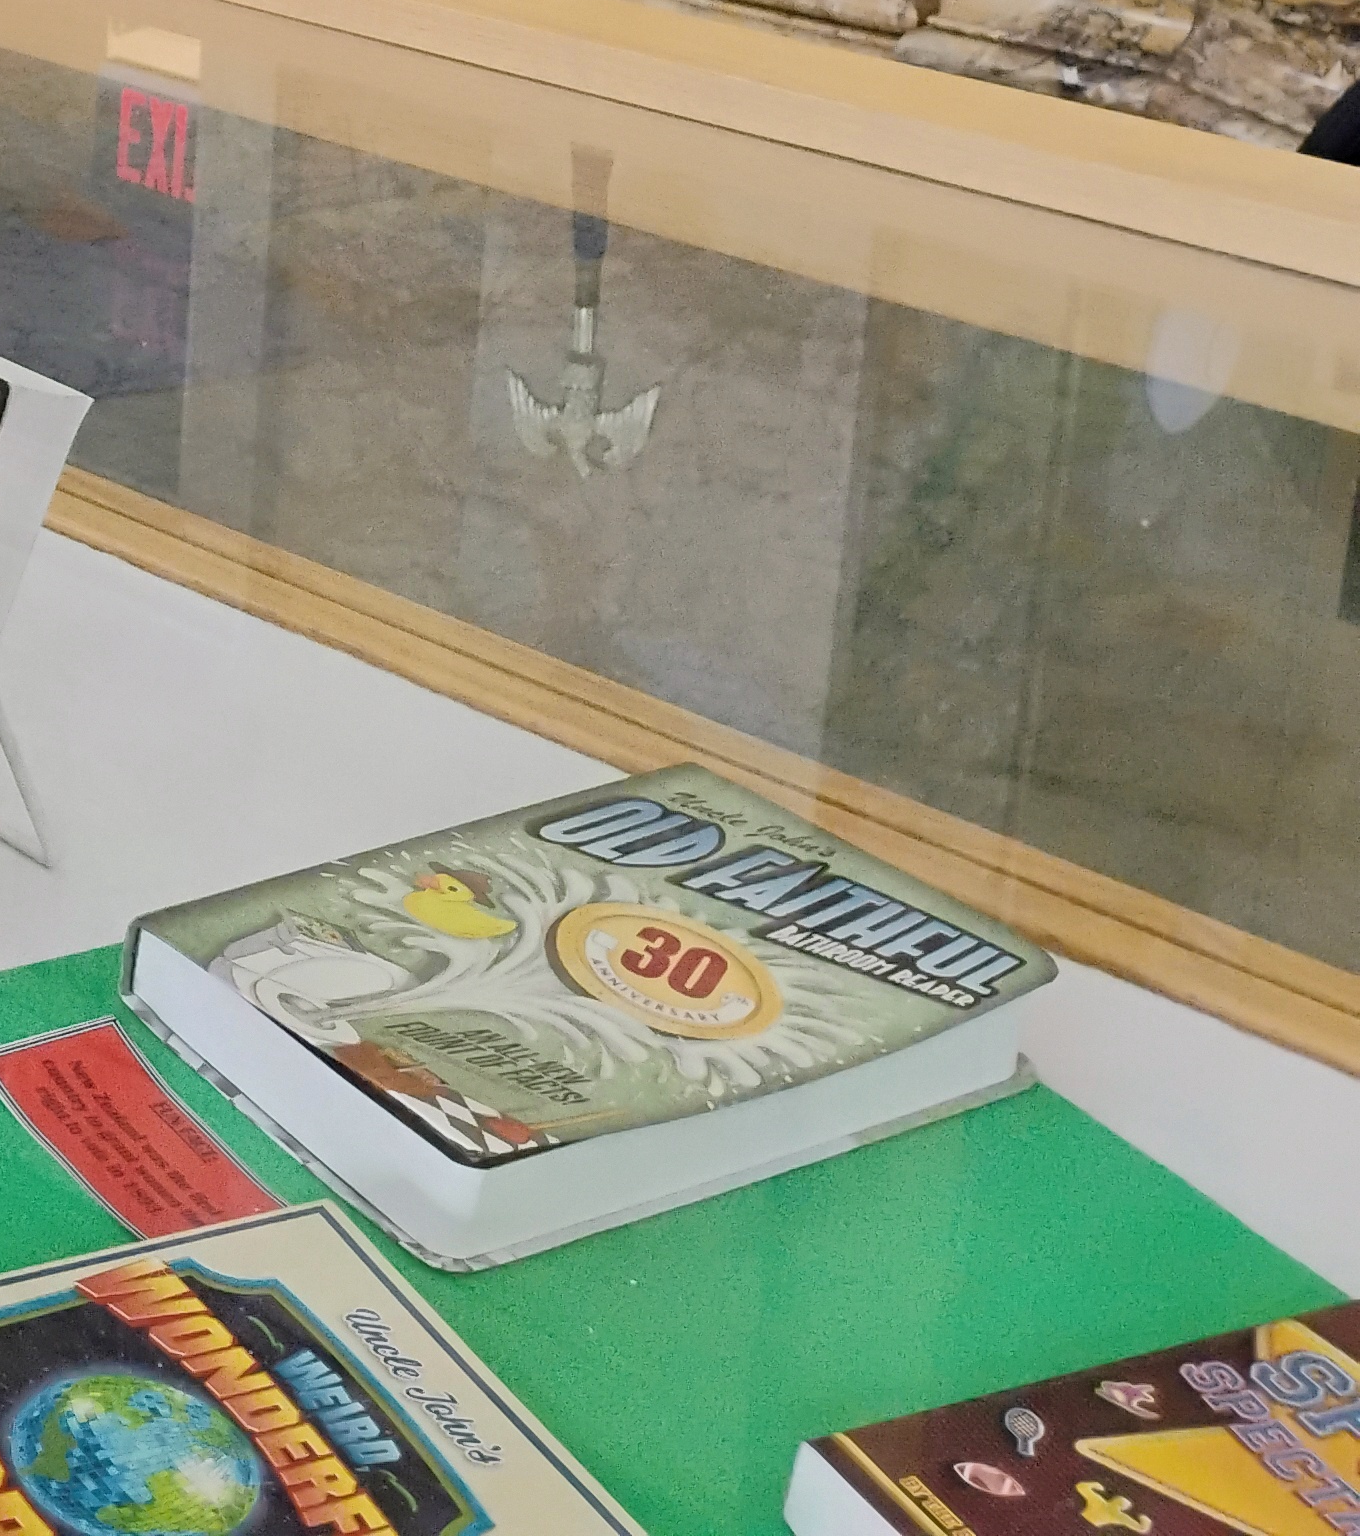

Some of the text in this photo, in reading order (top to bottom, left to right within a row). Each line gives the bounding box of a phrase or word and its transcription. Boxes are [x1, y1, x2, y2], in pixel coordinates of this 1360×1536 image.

[538, 796, 726, 867] OLD
[664, 791, 840, 858] Uncle John's
[670, 843, 1028, 997] FAITHFUL
[590, 956, 722, 1024] ANNIVERSARY
[618, 924, 730, 999] 30
[764, 924, 980, 1009] BATHROOM READER
[384, 1020, 592, 1107] FOUNT OF FACTS!
[452, 1027, 594, 1086] AN ALL-NEW
[68, 1059, 97, 1090] New
[92, 1092, 148, 1143] Zealand
[140, 1144, 170, 1170] was
[167, 1169, 193, 1190] the
[149, 1101, 182, 1127] FUN
[343, 1307, 506, 1468] Uncle John's
[898, 1473, 964, 1531] BY THE
